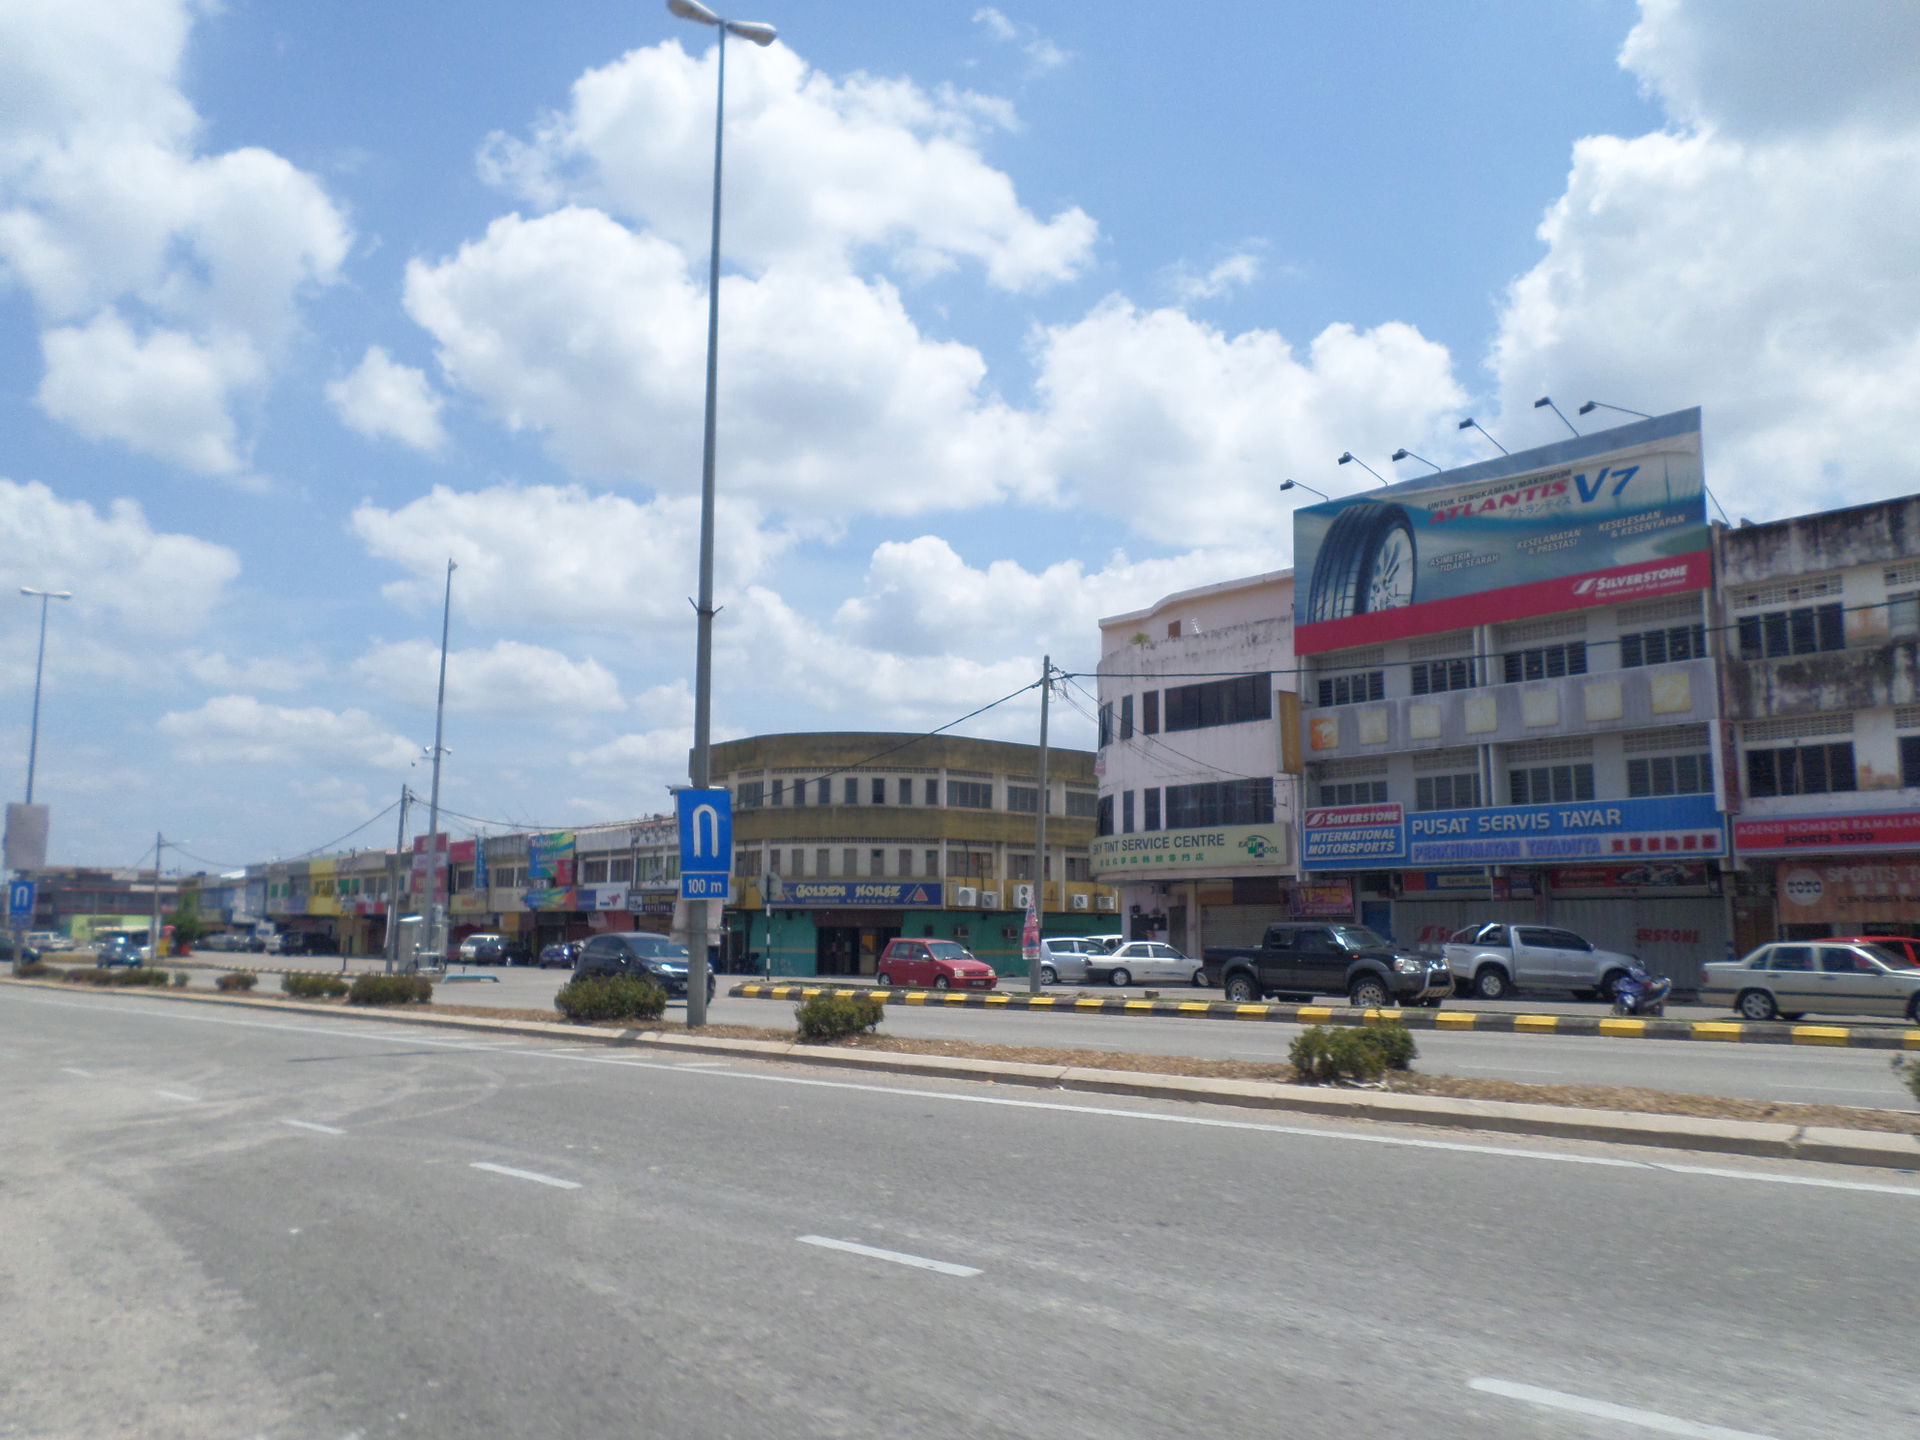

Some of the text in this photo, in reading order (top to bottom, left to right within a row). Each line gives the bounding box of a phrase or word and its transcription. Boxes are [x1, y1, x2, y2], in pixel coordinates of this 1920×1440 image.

[1427, 468, 1572, 511] UNTUK CENGKAMAN MAKSIMUM
[1427, 478, 1570, 525] ATLANTIS
[1598, 510, 1662, 532] KESELESAAN
[1620, 514, 1686, 537] KESENYAPAN
[1516, 528, 1582, 550] KESELAMATAN
[1536, 538, 1578, 554] PRESTASI
[1430, 551, 1472, 567] ASIMETRIK
[1439, 554, 1499, 573] TIDAK SEARAH
[1411, 808, 1623, 836] PUSAT SERVIS TAYAR
[1738, 823, 1785, 835] AGENSI
[1788, 820, 1849, 833] NOMBOR
[1104, 840, 1120, 853] TINT
[1121, 836, 1171, 852] SERVICE
[1173, 833, 1226, 849] CENTRE
[1310, 829, 1396, 843] INTERNATIONAL
[1784, 831, 1875, 844] SPORTS TOTO
[1308, 841, 1395, 855] MOTORSPORTS
[1826, 865, 1898, 882] SPORTS
[688, 879, 722, 893] 100 m
[796, 884, 901, 898] GOLDEN HORSE
[1787, 880, 1822, 894] TOTO
